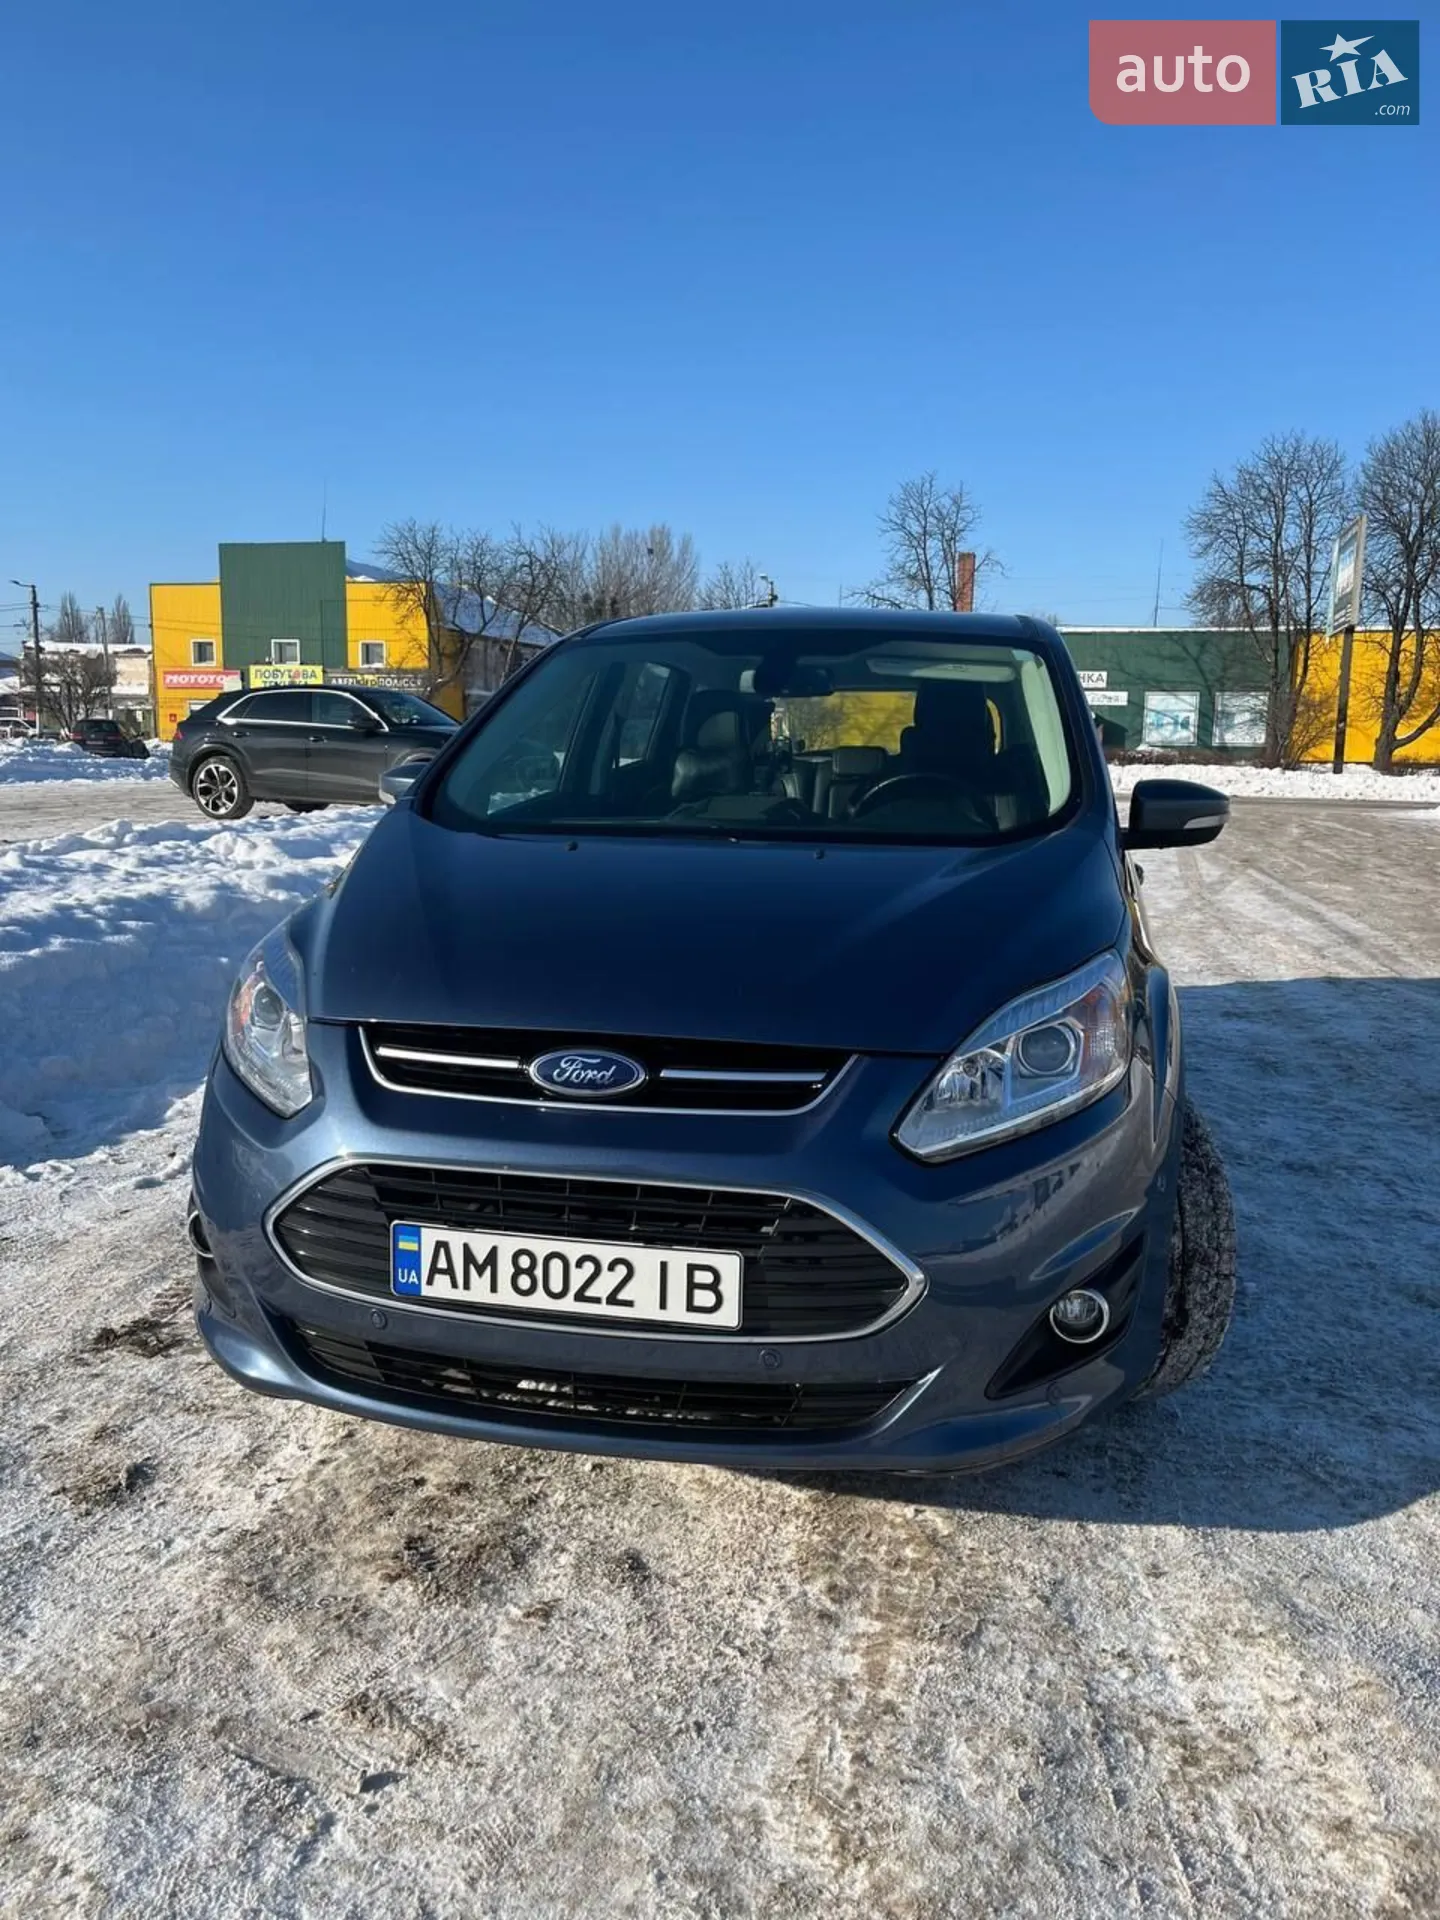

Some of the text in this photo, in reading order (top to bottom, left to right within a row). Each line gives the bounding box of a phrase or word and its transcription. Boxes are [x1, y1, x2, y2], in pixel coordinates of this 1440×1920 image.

[254, 668, 318, 680] ПОБУТОВА
[552, 1055, 617, 1086] Ford
[398, 1267, 419, 1285] UA
[425, 1240, 724, 1315] AM 8022 IB
